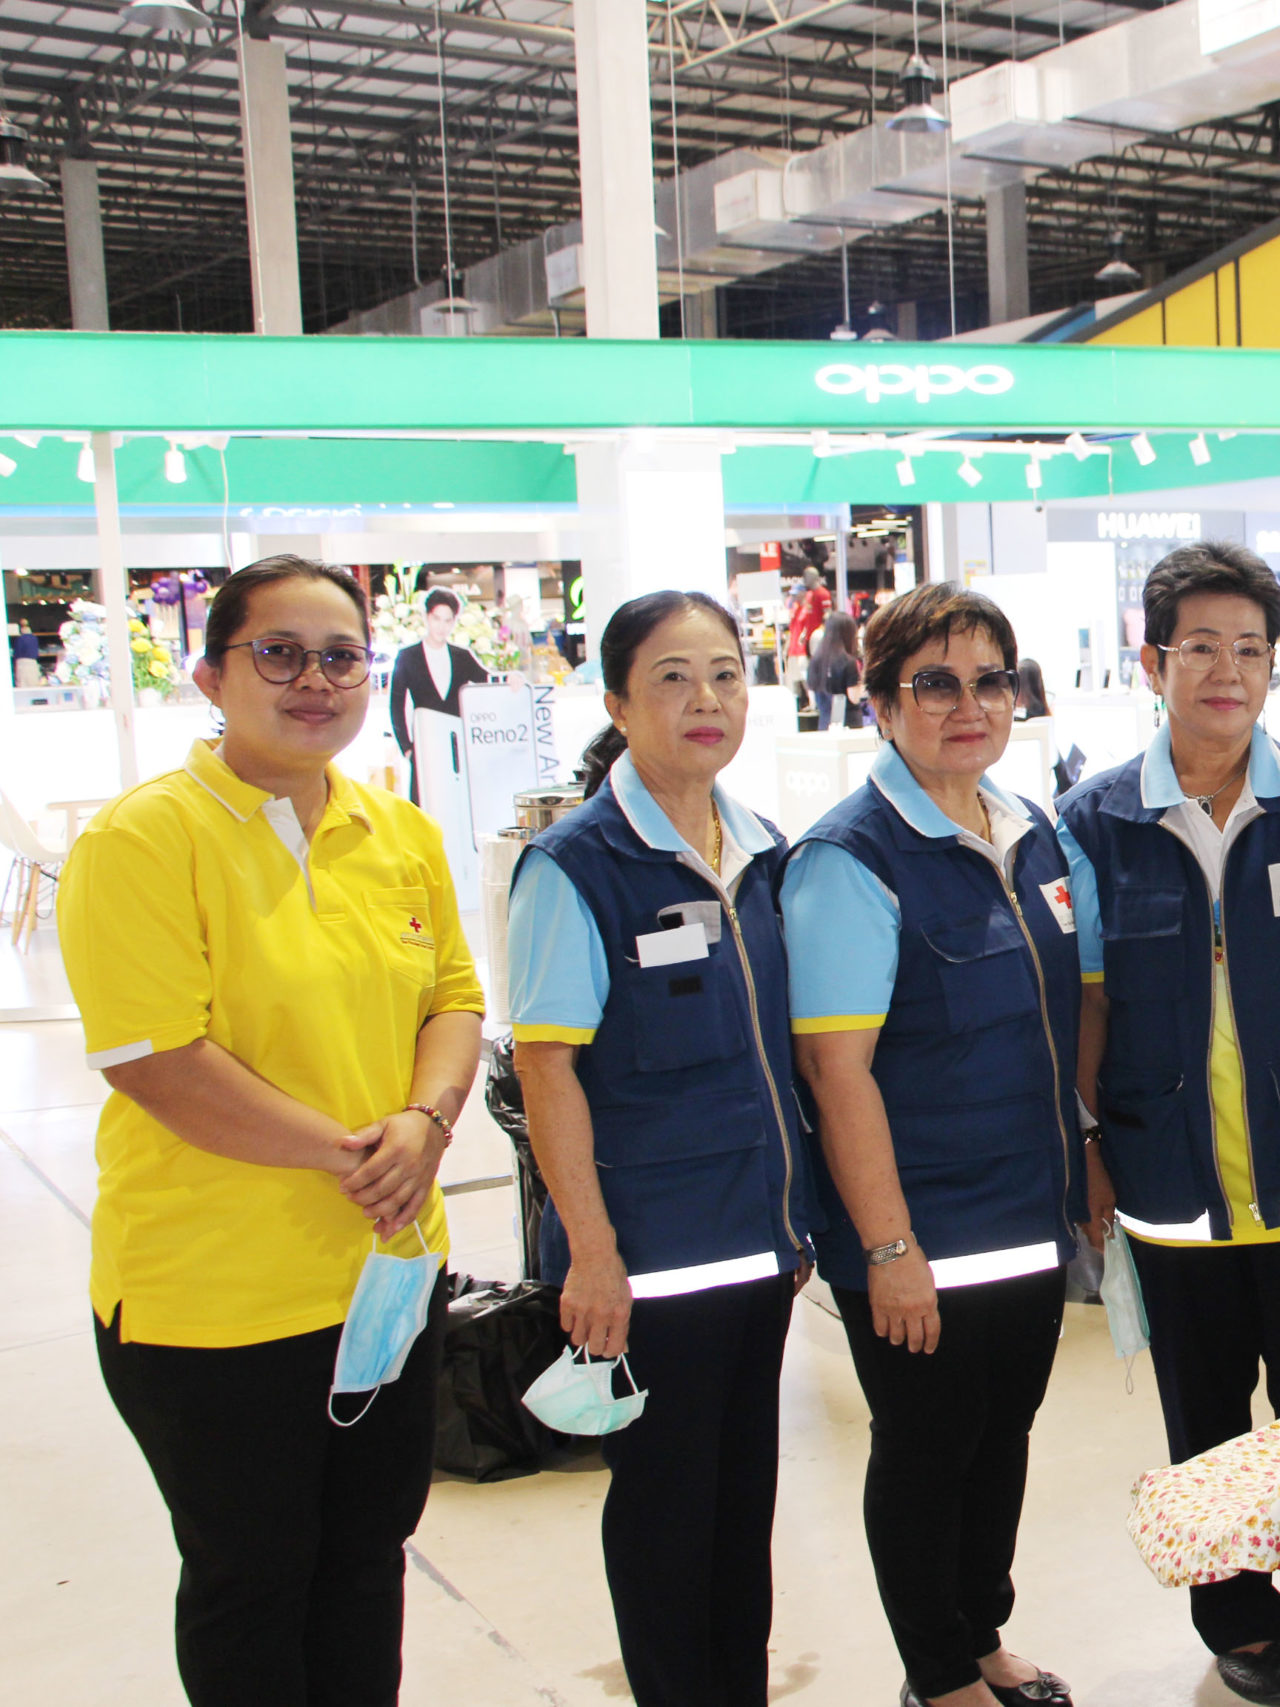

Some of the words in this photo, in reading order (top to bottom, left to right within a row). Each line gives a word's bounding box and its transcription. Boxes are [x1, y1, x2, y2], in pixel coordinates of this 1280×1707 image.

[1098, 512, 1201, 539] HUAWEI
[534, 685, 555, 746] New
[470, 723, 528, 745] Reno2
